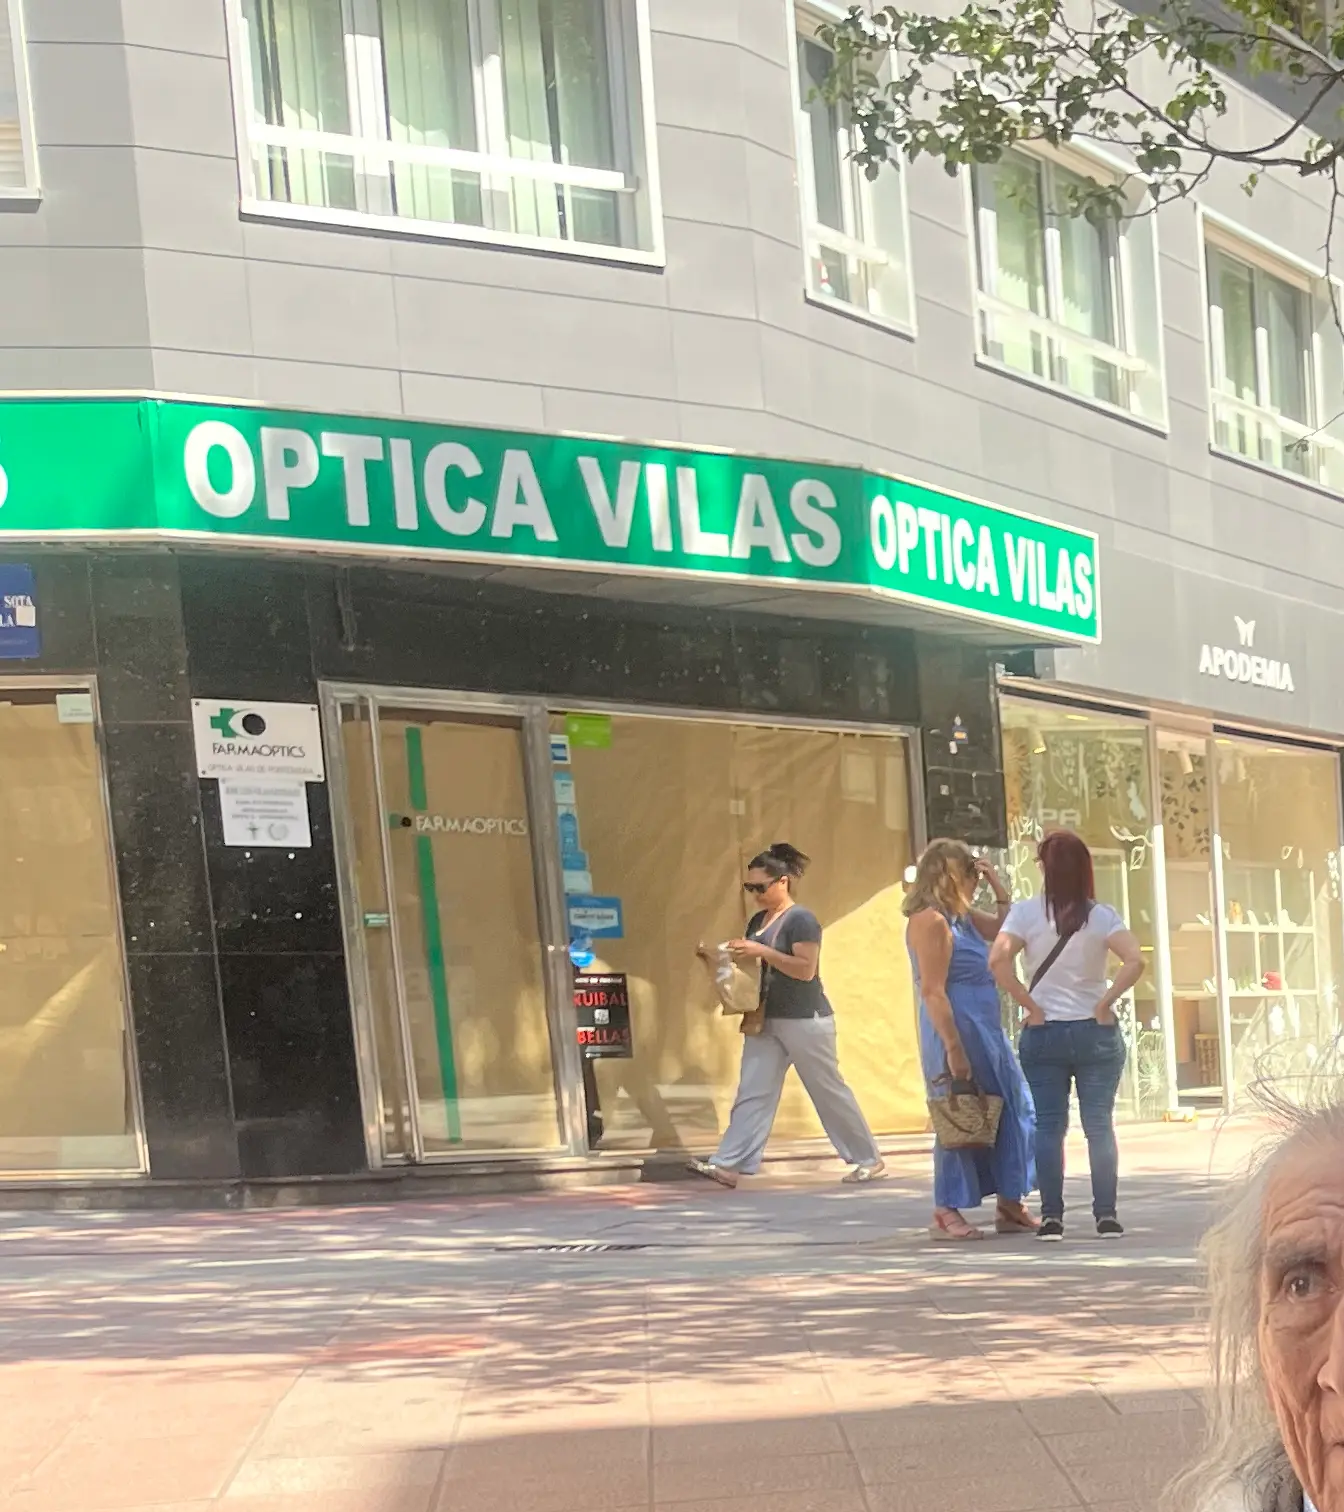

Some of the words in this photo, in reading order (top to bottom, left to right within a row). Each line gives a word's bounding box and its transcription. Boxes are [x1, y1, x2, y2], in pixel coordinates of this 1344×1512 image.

[183, 420, 559, 542] OPTICA
[577, 456, 842, 567] VILAS
[870, 494, 1001, 597] OPTICA
[1003, 531, 1093, 619] VILAS
[1199, 643, 1295, 692] APODEMIA
[212, 742, 306, 758] FARMAOPTICS
[415, 815, 528, 836] FARMAOPTICS
